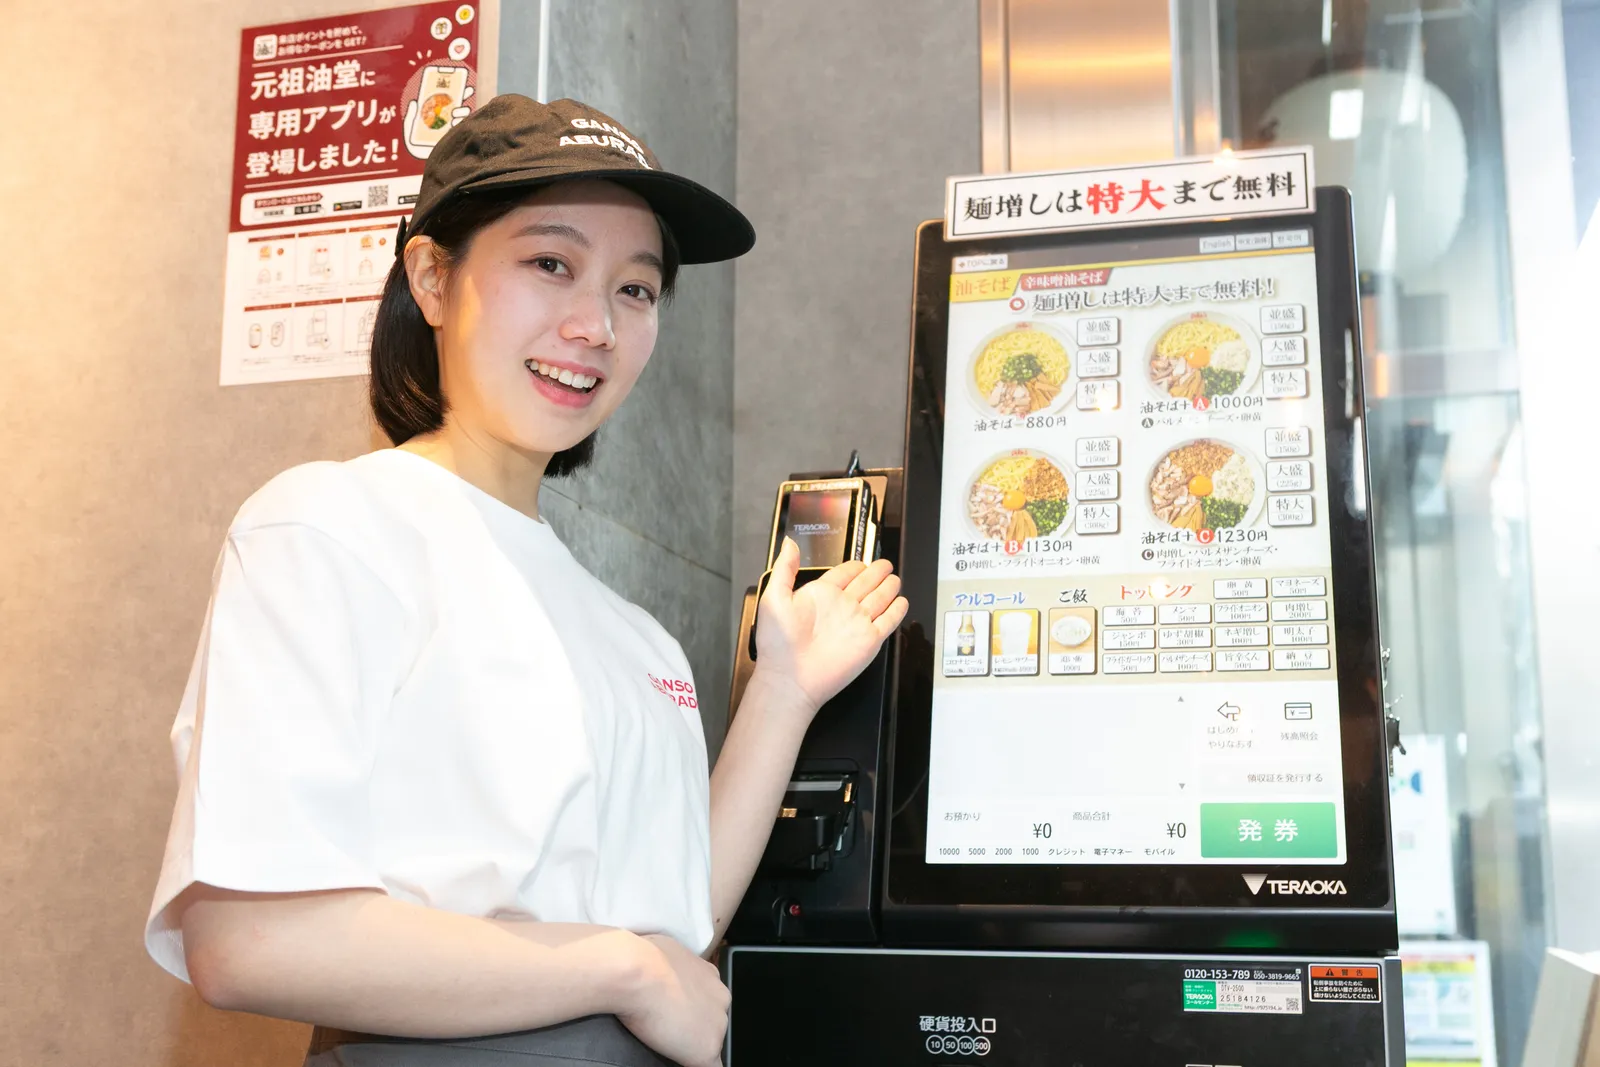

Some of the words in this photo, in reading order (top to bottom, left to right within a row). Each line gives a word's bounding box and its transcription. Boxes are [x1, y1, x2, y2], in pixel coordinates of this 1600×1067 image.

[343, 36, 367, 47] GET!
[250, 59, 376, 101] 元祖油堂に
[248, 99, 397, 140] 専用アプリが
[963, 171, 1296, 221] 麺増しは特大まで無料
[1203, 238, 1231, 249] English
[1025, 271, 1105, 289] 辛味噌油そば
[955, 277, 1011, 296] 油そば
[1270, 308, 1296, 320] 並盛
[1085, 320, 1111, 332] 並盛
[1272, 338, 1297, 351] 大盛
[1086, 352, 1111, 364] 大盛
[1271, 371, 1298, 384] 特大
[1085, 440, 1111, 452] 並盛
[1277, 464, 1303, 476] 大盛
[1086, 472, 1111, 485] 大盛
[1276, 498, 1304, 511] 特大
[1083, 506, 1111, 519] 特大
[793, 523, 831, 533] TERAOKA
[1217, 529, 1268, 543] 1230円
[1026, 539, 1073, 552] 1130円
[1276, 578, 1320, 587] マヨネーズ
[955, 591, 1027, 607] アルコール
[1059, 589, 1088, 604] ご飯
[1173, 606, 1197, 614] メンマ
[1285, 602, 1314, 611] 肉増し
[1224, 627, 1260, 636] ネギ増し
[1284, 627, 1315, 636] 明太子
[1280, 731, 1319, 741] 残高照会
[1208, 740, 1254, 749] やりなおす
[1247, 773, 1324, 783] 領収証を発行する
[944, 811, 982, 822] お預かり
[1072, 811, 1112, 821] 商品合計
[1032, 822, 1052, 838] ¥0
[1166, 822, 1187, 838] ¥0
[938, 847, 960, 856] 10000
[968, 847, 986, 856] 5000
[994, 847, 1013, 856] 2000
[1021, 847, 1040, 856] 1000
[1048, 847, 1086, 856] クレジット
[1093, 847, 1133, 856] 電子マネー
[1143, 847, 1176, 856] モバイル
[1267, 879, 1348, 895] TERAOKA
[1184, 968, 1251, 979] 0120-153-789
[919, 1015, 997, 1033] 硬貨投入口
[931, 1040, 941, 1049] 10
[945, 1041, 956, 1049] 50
[960, 1041, 972, 1050] 100
[974, 1042, 988, 1050] 500
